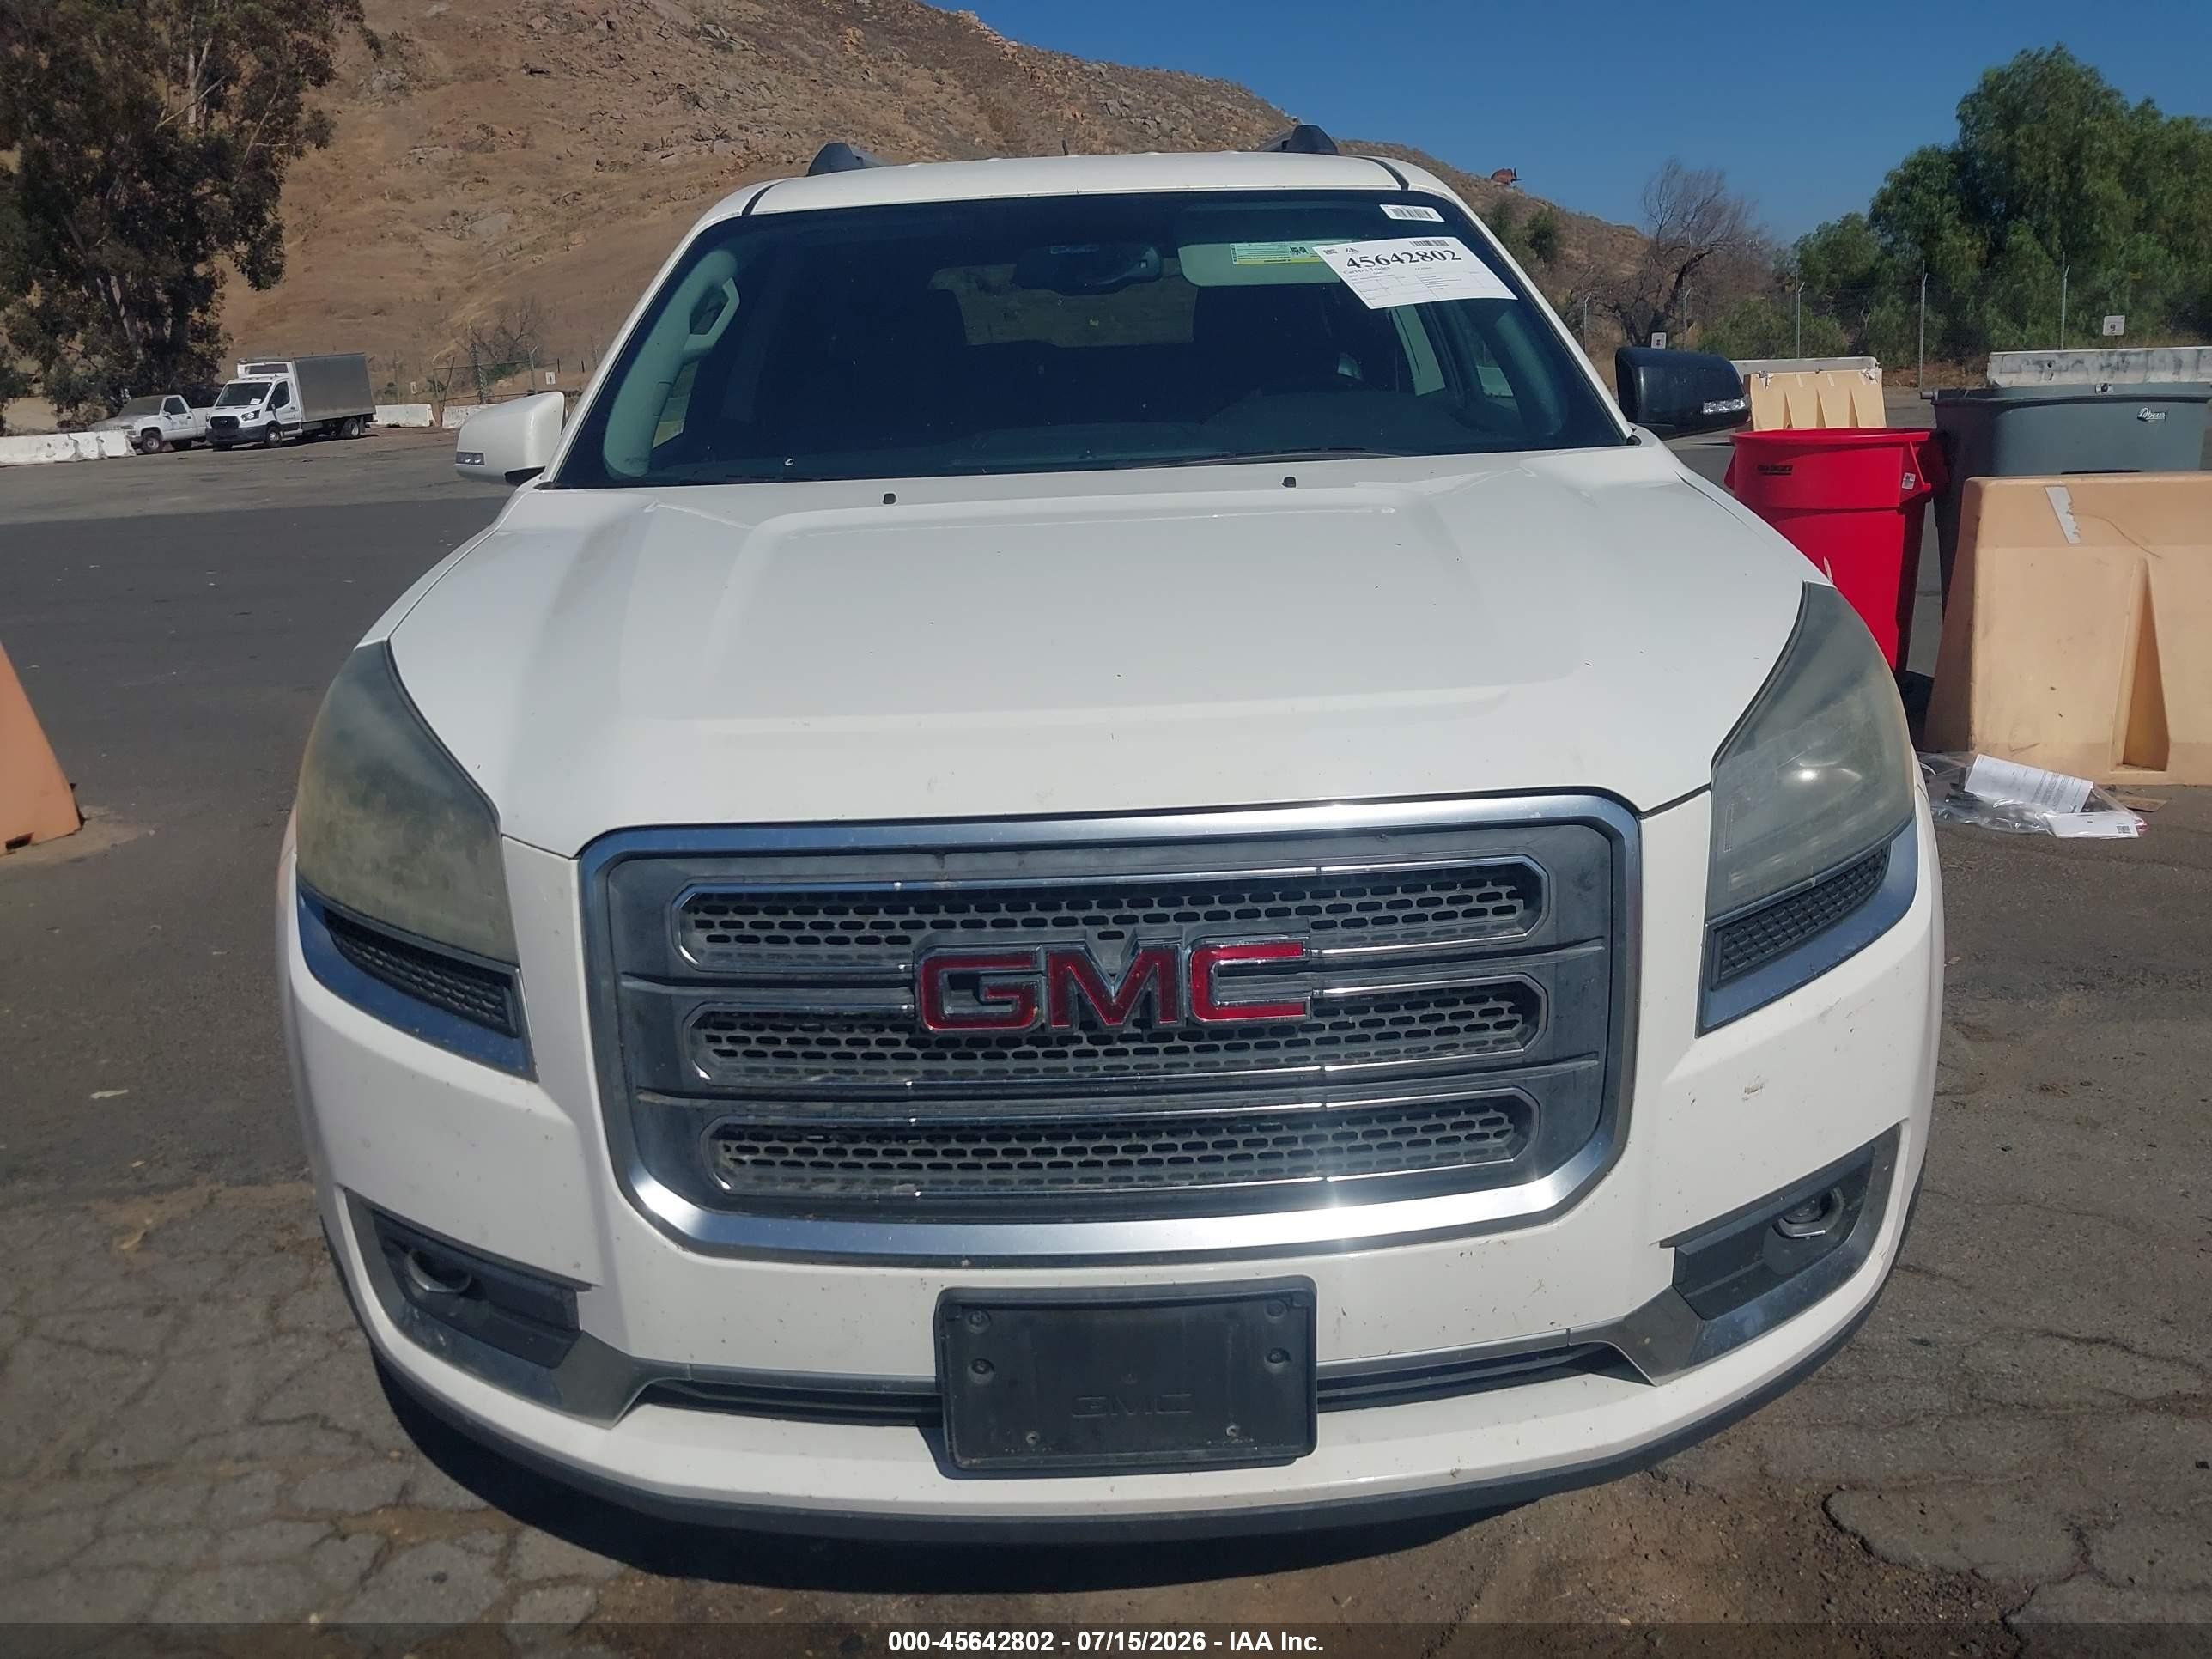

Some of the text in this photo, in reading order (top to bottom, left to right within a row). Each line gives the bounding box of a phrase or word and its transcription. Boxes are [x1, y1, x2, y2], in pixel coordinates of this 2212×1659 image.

[1346, 249, 1462, 269] 45642802
[915, 936, 1312, 1033] GMC
[1071, 1393, 1193, 1419] GMC
